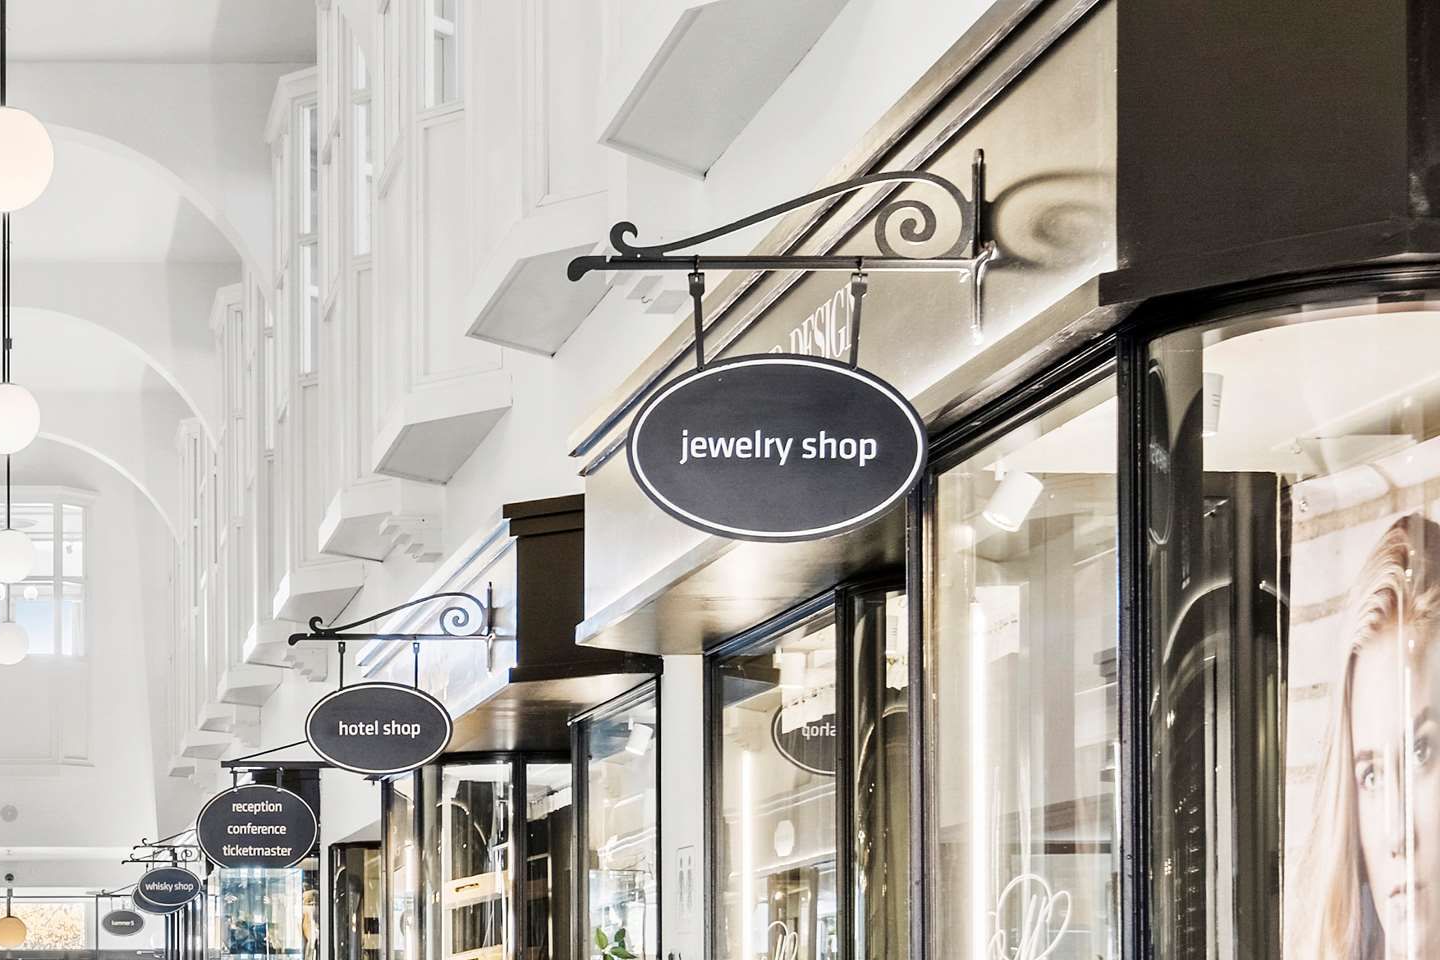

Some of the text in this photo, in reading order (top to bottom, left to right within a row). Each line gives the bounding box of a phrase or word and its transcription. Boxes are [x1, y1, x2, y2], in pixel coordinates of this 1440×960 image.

[679, 429, 878, 467] jewelry shop
[338, 720, 421, 739] hotel shop
[231, 800, 283, 815] reception
[226, 822, 287, 835] conference
[222, 844, 293, 856] ticketmaster
[144, 881, 194, 893] whisky shop
